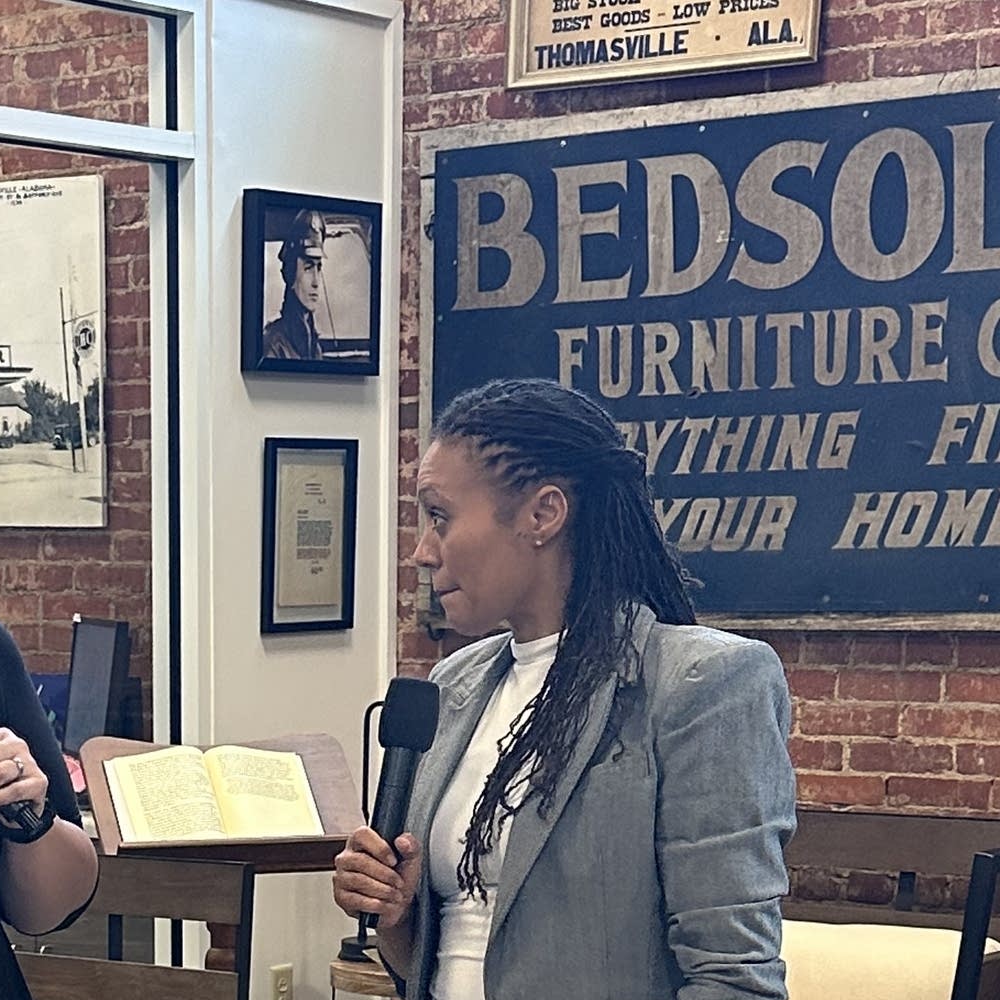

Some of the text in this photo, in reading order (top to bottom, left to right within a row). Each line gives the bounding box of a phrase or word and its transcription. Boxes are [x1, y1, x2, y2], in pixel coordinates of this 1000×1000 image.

[552, 15, 592, 33] BEST
[600, 9, 650, 28] GOODS
[673, 1, 711, 20] LOW
[534, 30, 689, 70] THOMASVILLE
[553, 297, 948, 398] FURNITURE
[615, 402, 1000, 476] YTHING FI
[654, 496, 797, 552] YOUR
